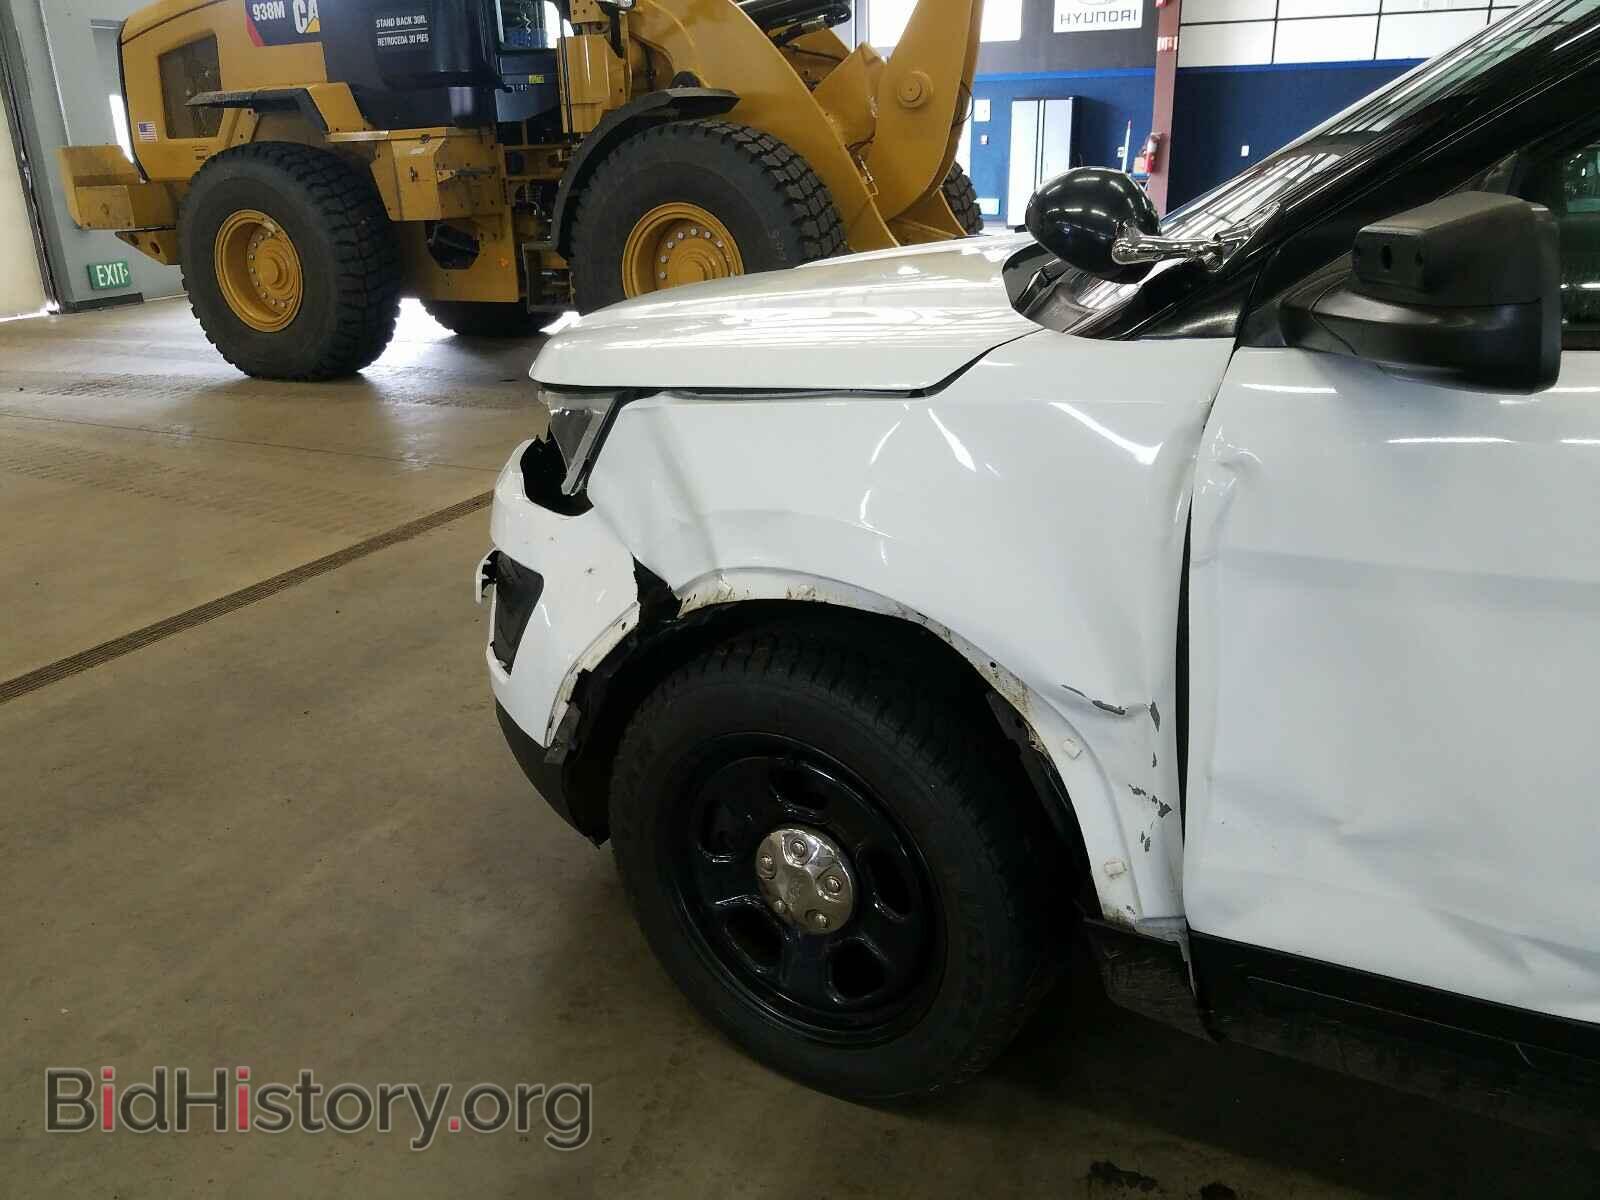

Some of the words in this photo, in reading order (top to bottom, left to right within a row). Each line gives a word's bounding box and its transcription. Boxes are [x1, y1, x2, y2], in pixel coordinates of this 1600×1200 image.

[252, 1, 286, 21] 938M
[1060, 9, 1137, 24] HYUNDAI
[376, 18, 395, 28] STAND
[396, 16, 412, 26] BACK
[377, 36, 408, 46] RETROCEDA
[416, 34, 429, 43] PIES
[96, 263, 125, 286] EXIT
